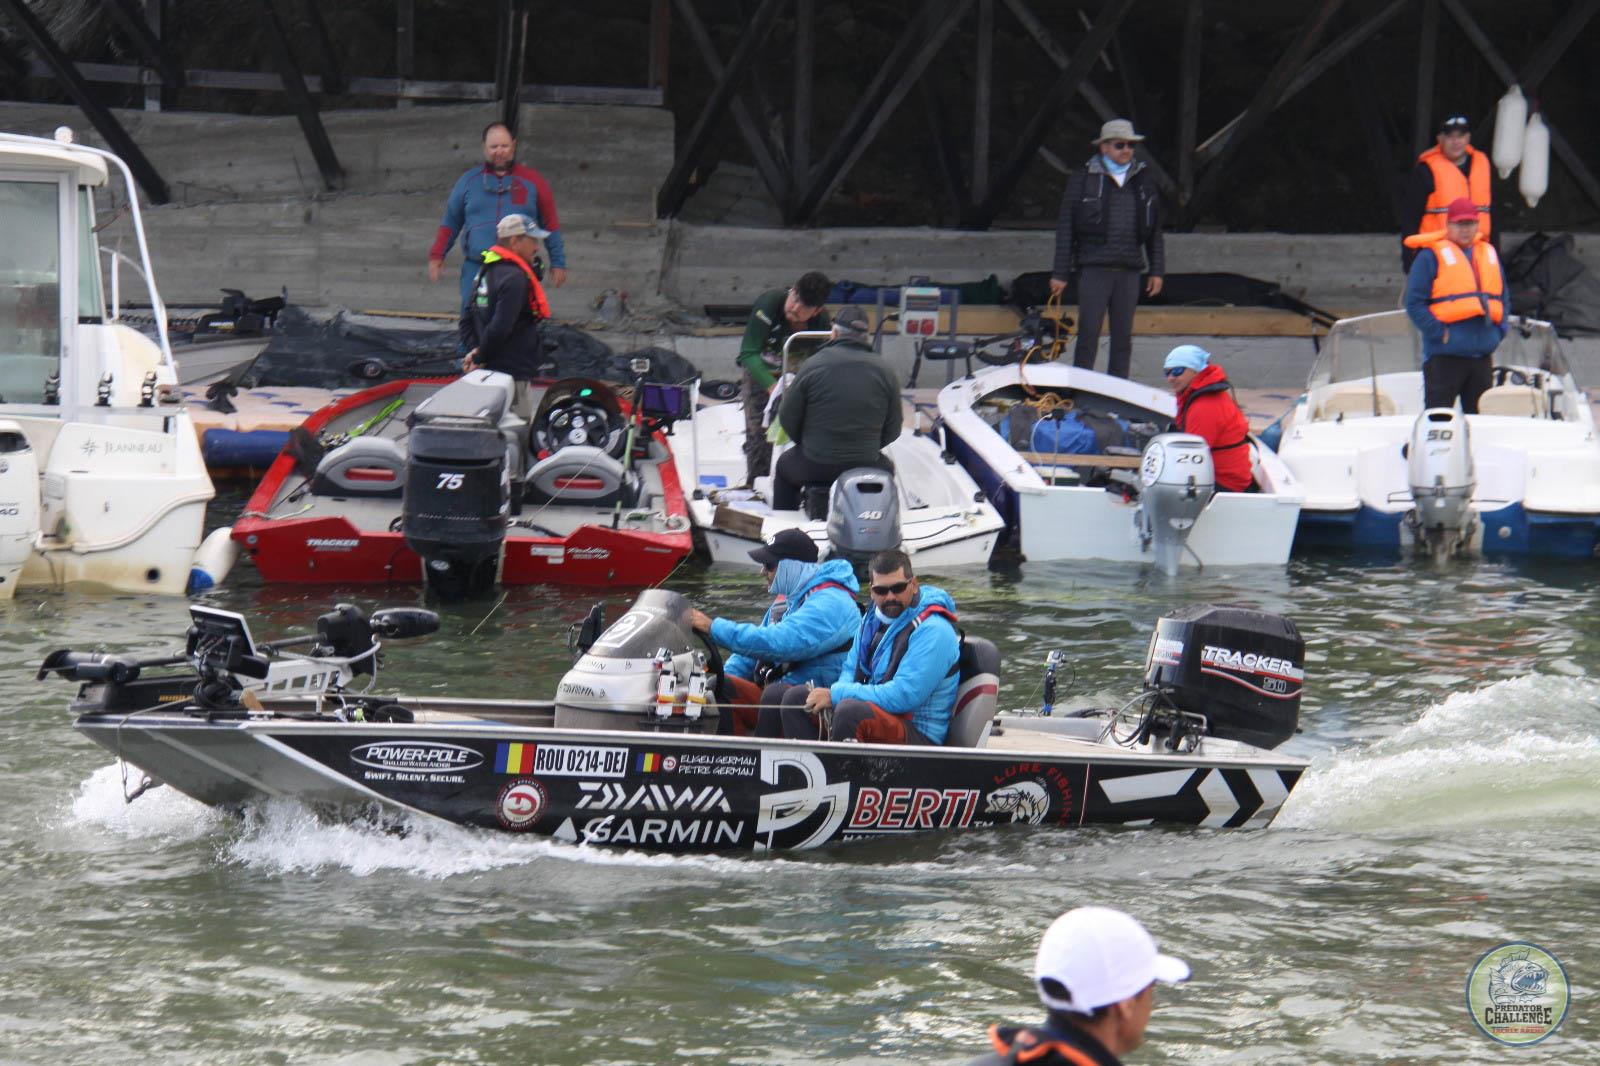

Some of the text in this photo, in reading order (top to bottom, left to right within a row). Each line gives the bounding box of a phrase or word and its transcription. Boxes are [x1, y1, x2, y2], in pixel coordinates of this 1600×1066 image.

[1427, 429, 1453, 441] 50
[1176, 453, 1204, 465] 20
[436, 472, 465, 490] 75
[856, 510, 883, 520] 40
[307, 538, 359, 547] TRACKER
[1202, 645, 1292, 676] TRACKER
[366, 747, 469, 763] POWER-POLE
[536, 747, 627, 774] ROU 0214-DEJ
[715, 755, 757, 767] GERMAN
[678, 765, 755, 777] PETRE GERMAN
[575, 782, 732, 813] DAIWA
[848, 787, 981, 829] BERTI
[582, 817, 745, 845] GARMIN
